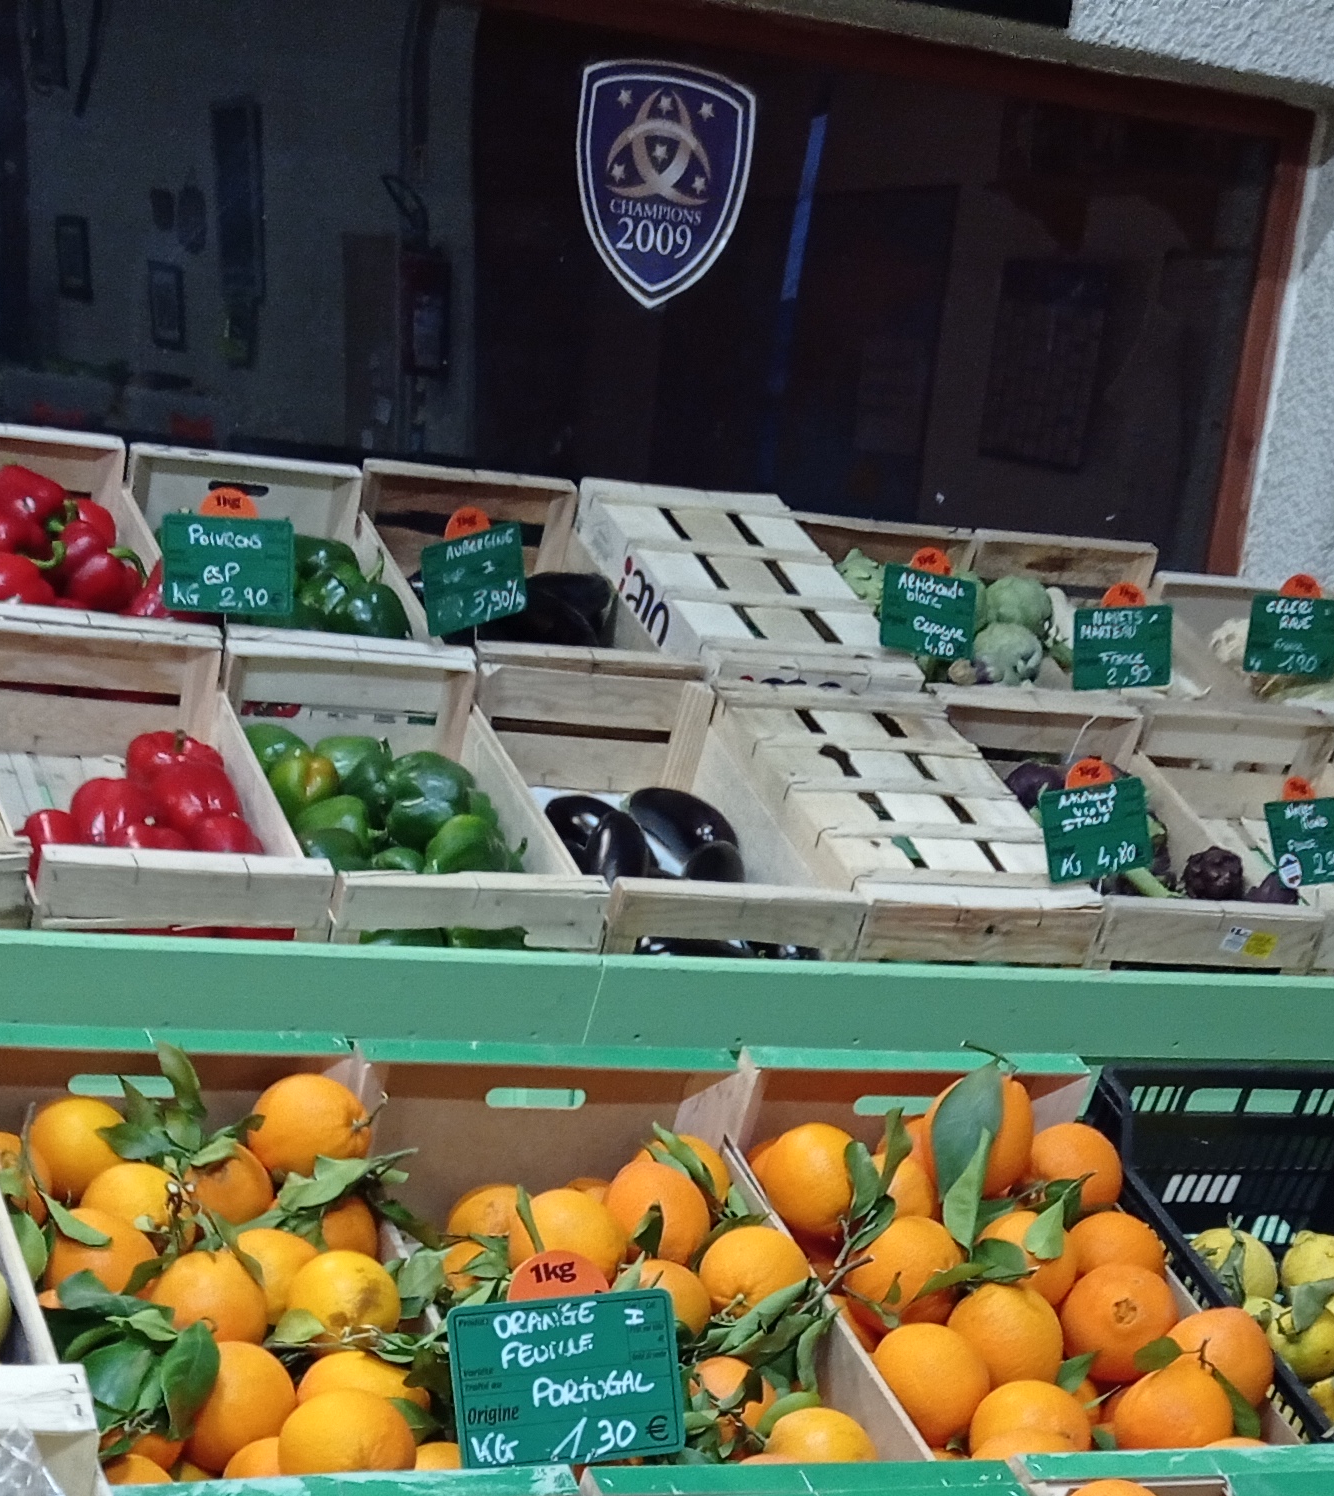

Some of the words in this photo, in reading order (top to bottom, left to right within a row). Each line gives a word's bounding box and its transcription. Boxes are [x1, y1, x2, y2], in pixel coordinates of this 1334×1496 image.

[609, 198, 702, 225] CHAMPIONS
[617, 217, 693, 259] 2009
[216, 495, 241, 509] 1kg
[203, 562, 240, 586] ESP
[219, 586, 269, 608] 2,90
[1107, 664, 1153, 686] 2,90
[1097, 841, 1137, 872] 4,80
[530, 1261, 577, 1284] 1kg
[493, 1301, 598, 1339] ORANGE
[467, 1402, 520, 1427] Origine
[550, 1416, 637, 1464] 1,30
